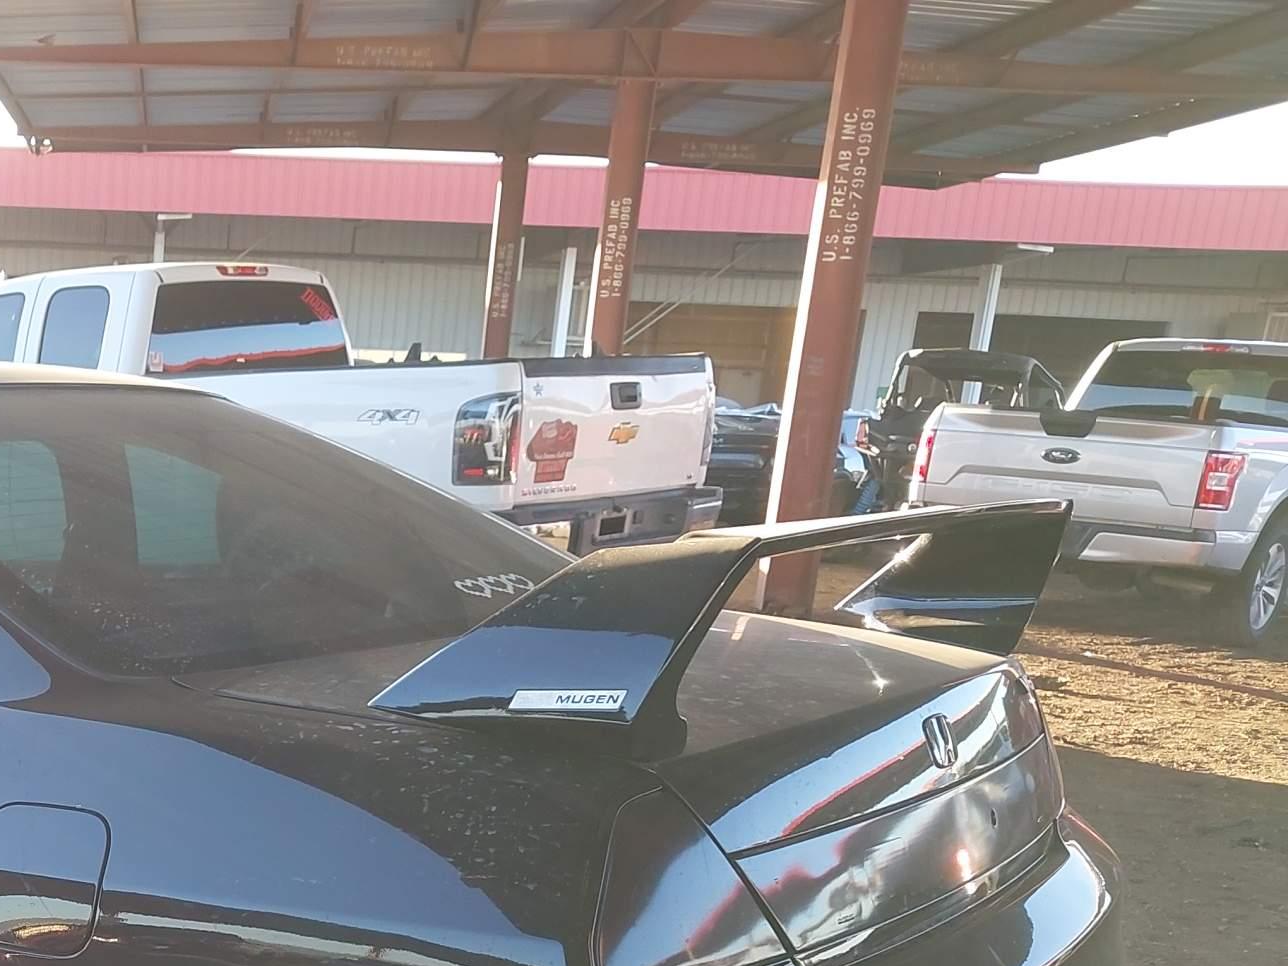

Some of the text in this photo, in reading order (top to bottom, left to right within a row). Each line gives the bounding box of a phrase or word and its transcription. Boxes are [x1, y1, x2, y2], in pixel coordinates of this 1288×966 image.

[822, 107, 860, 262] U.S. PREFAB INC.
[839, 108, 876, 260] 1-866-799-0969
[603, 224, 618, 270] PREFAB
[555, 694, 621, 705] MUGEN
